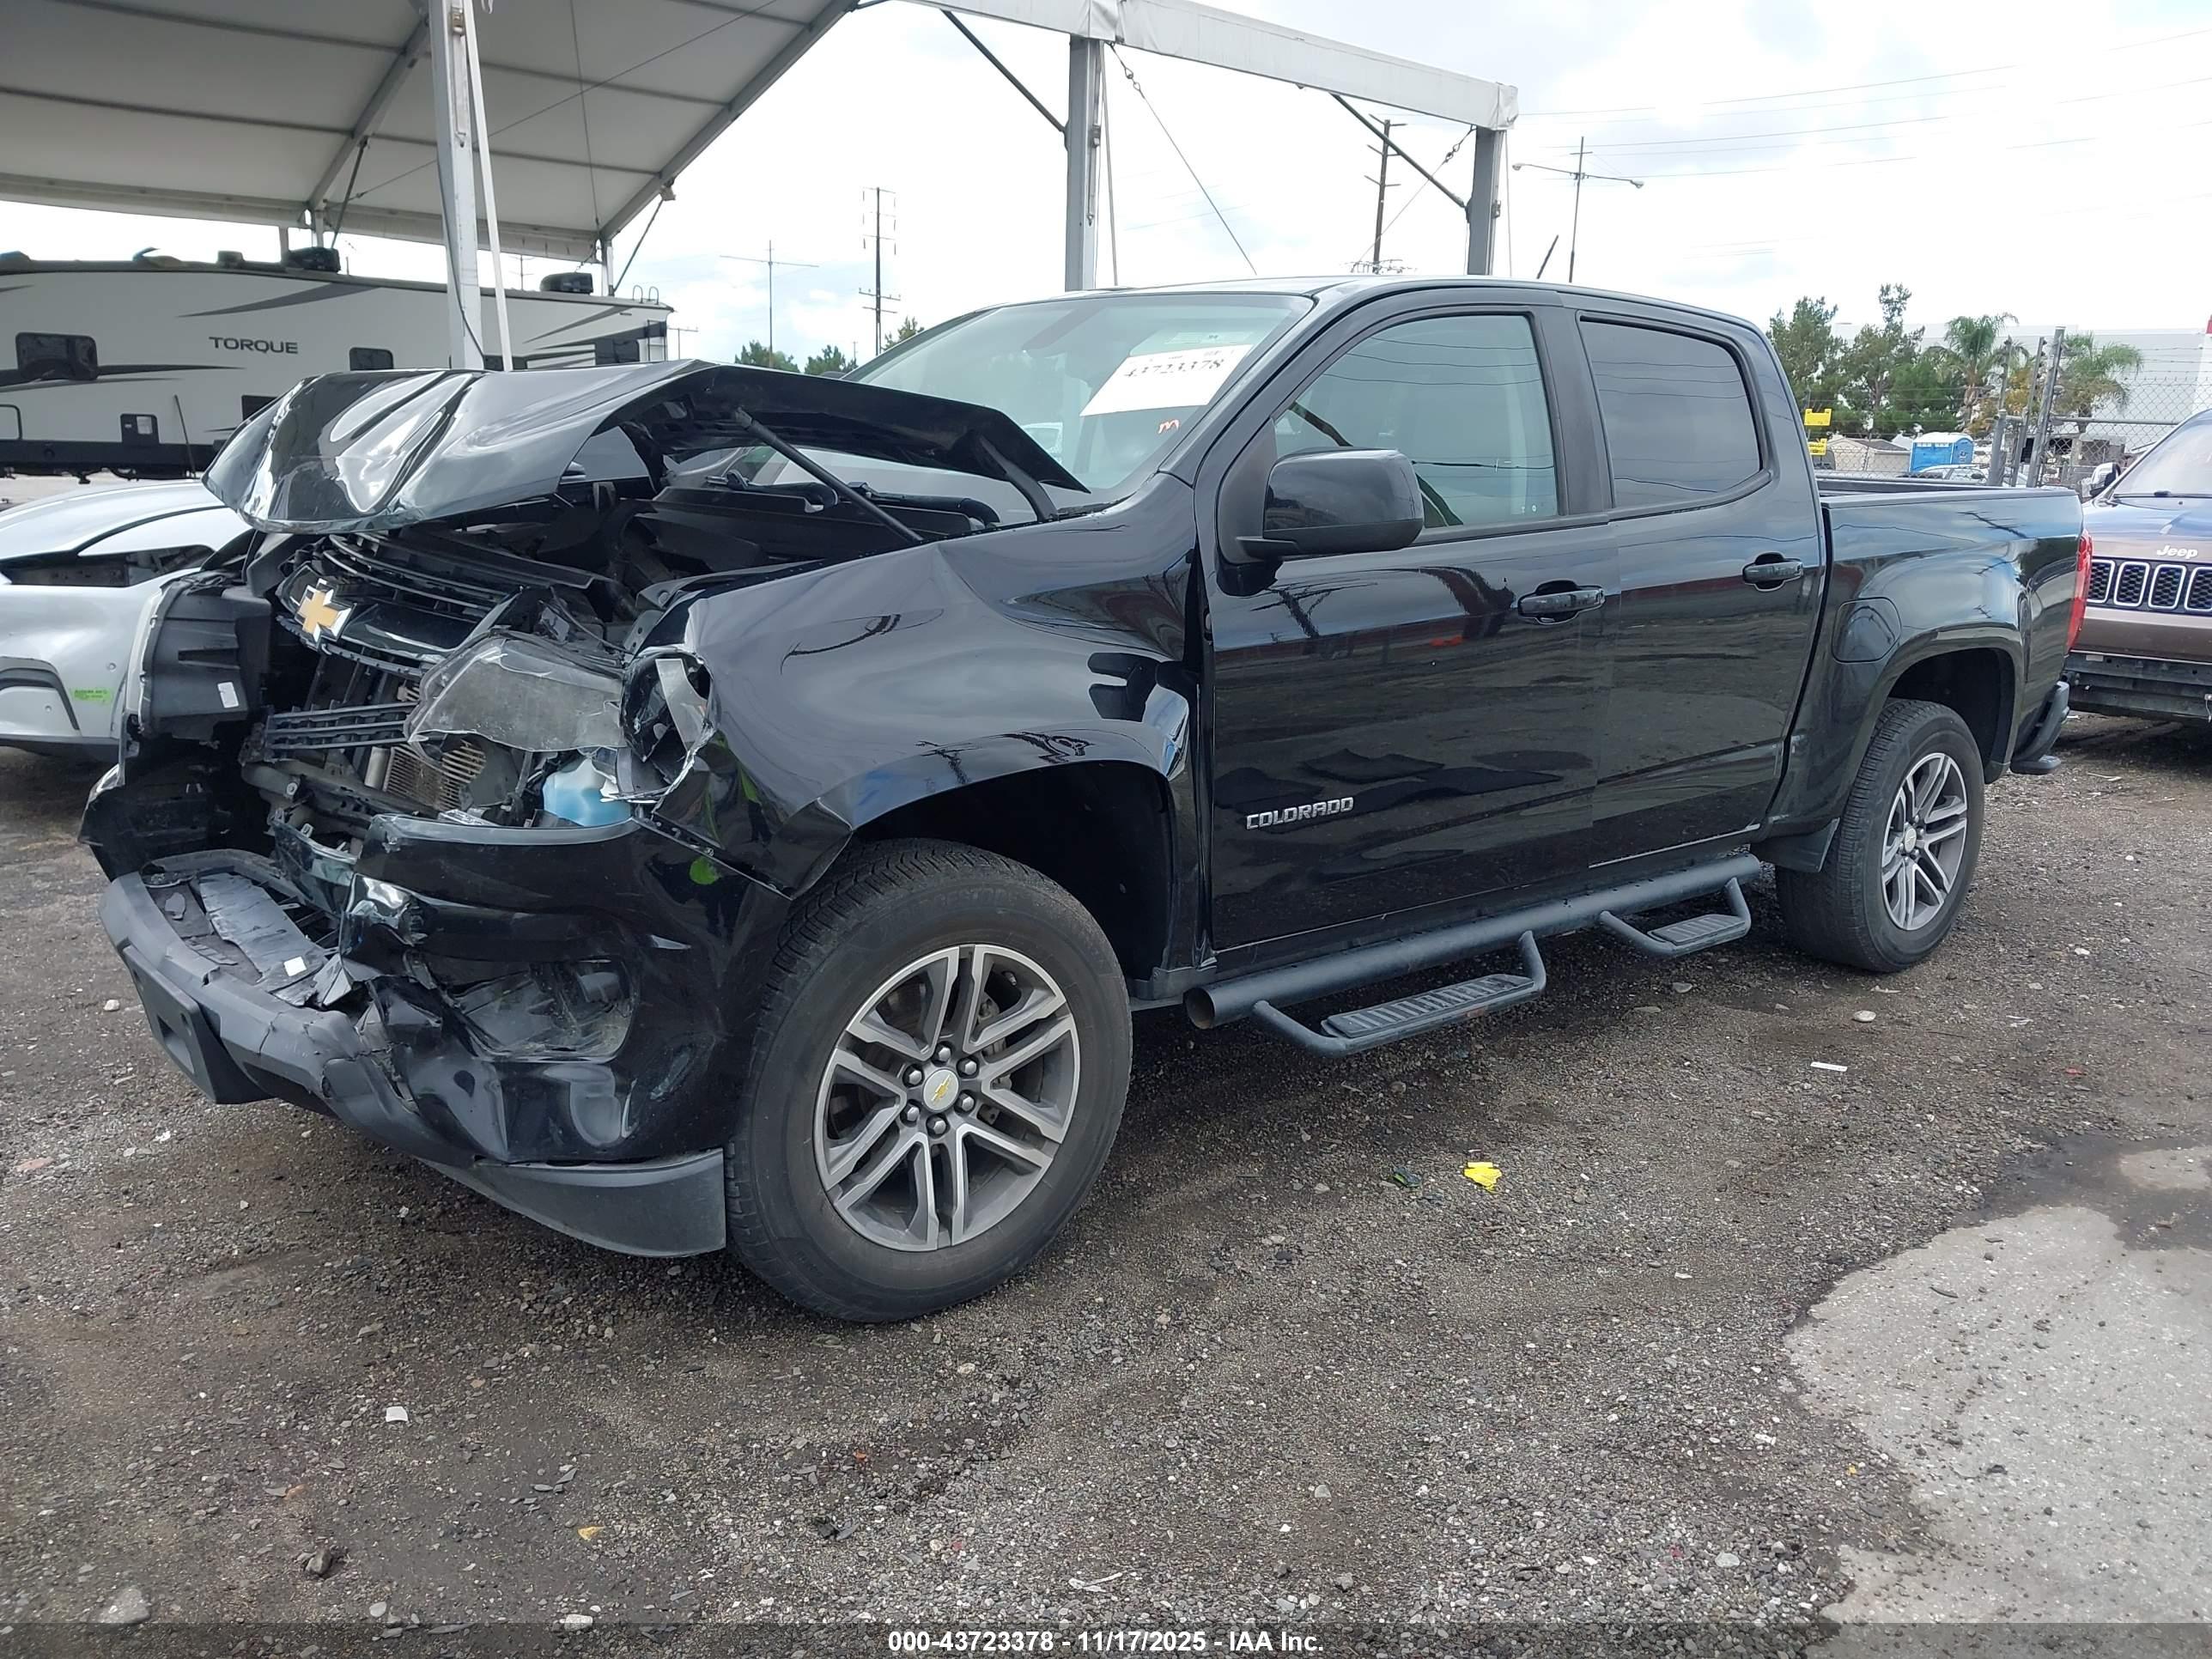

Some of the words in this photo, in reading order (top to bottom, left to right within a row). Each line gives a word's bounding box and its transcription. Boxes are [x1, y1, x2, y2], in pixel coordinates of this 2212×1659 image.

[209, 337, 298, 354] TORQUE
[2156, 544, 2198, 560] Jeep
[1246, 797, 1354, 830] COLORADO
